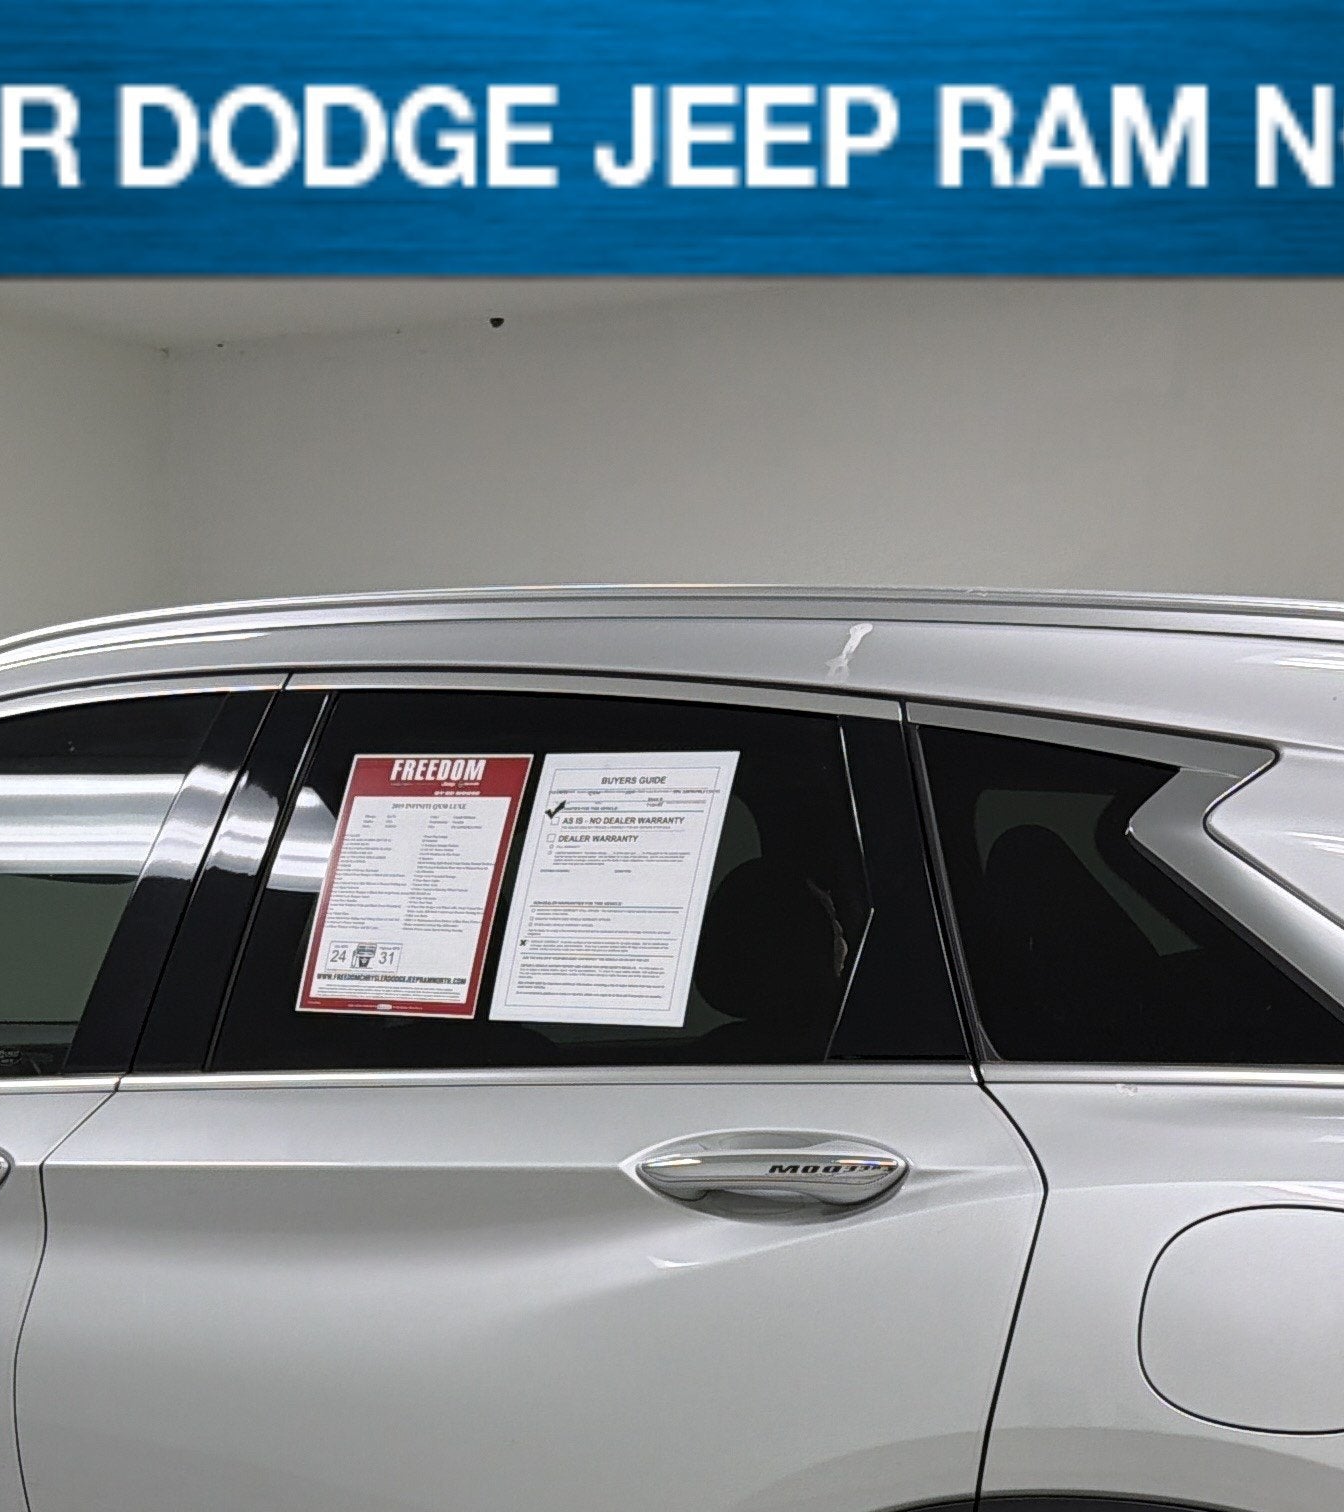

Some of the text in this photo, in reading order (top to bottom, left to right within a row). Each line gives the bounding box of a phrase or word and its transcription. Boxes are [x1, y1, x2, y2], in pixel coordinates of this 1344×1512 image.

[389, 759, 487, 781] FREEDOM
[601, 775, 668, 785] BUYERS GUIDE
[329, 950, 347, 963] 24
[378, 951, 395, 965] 31
